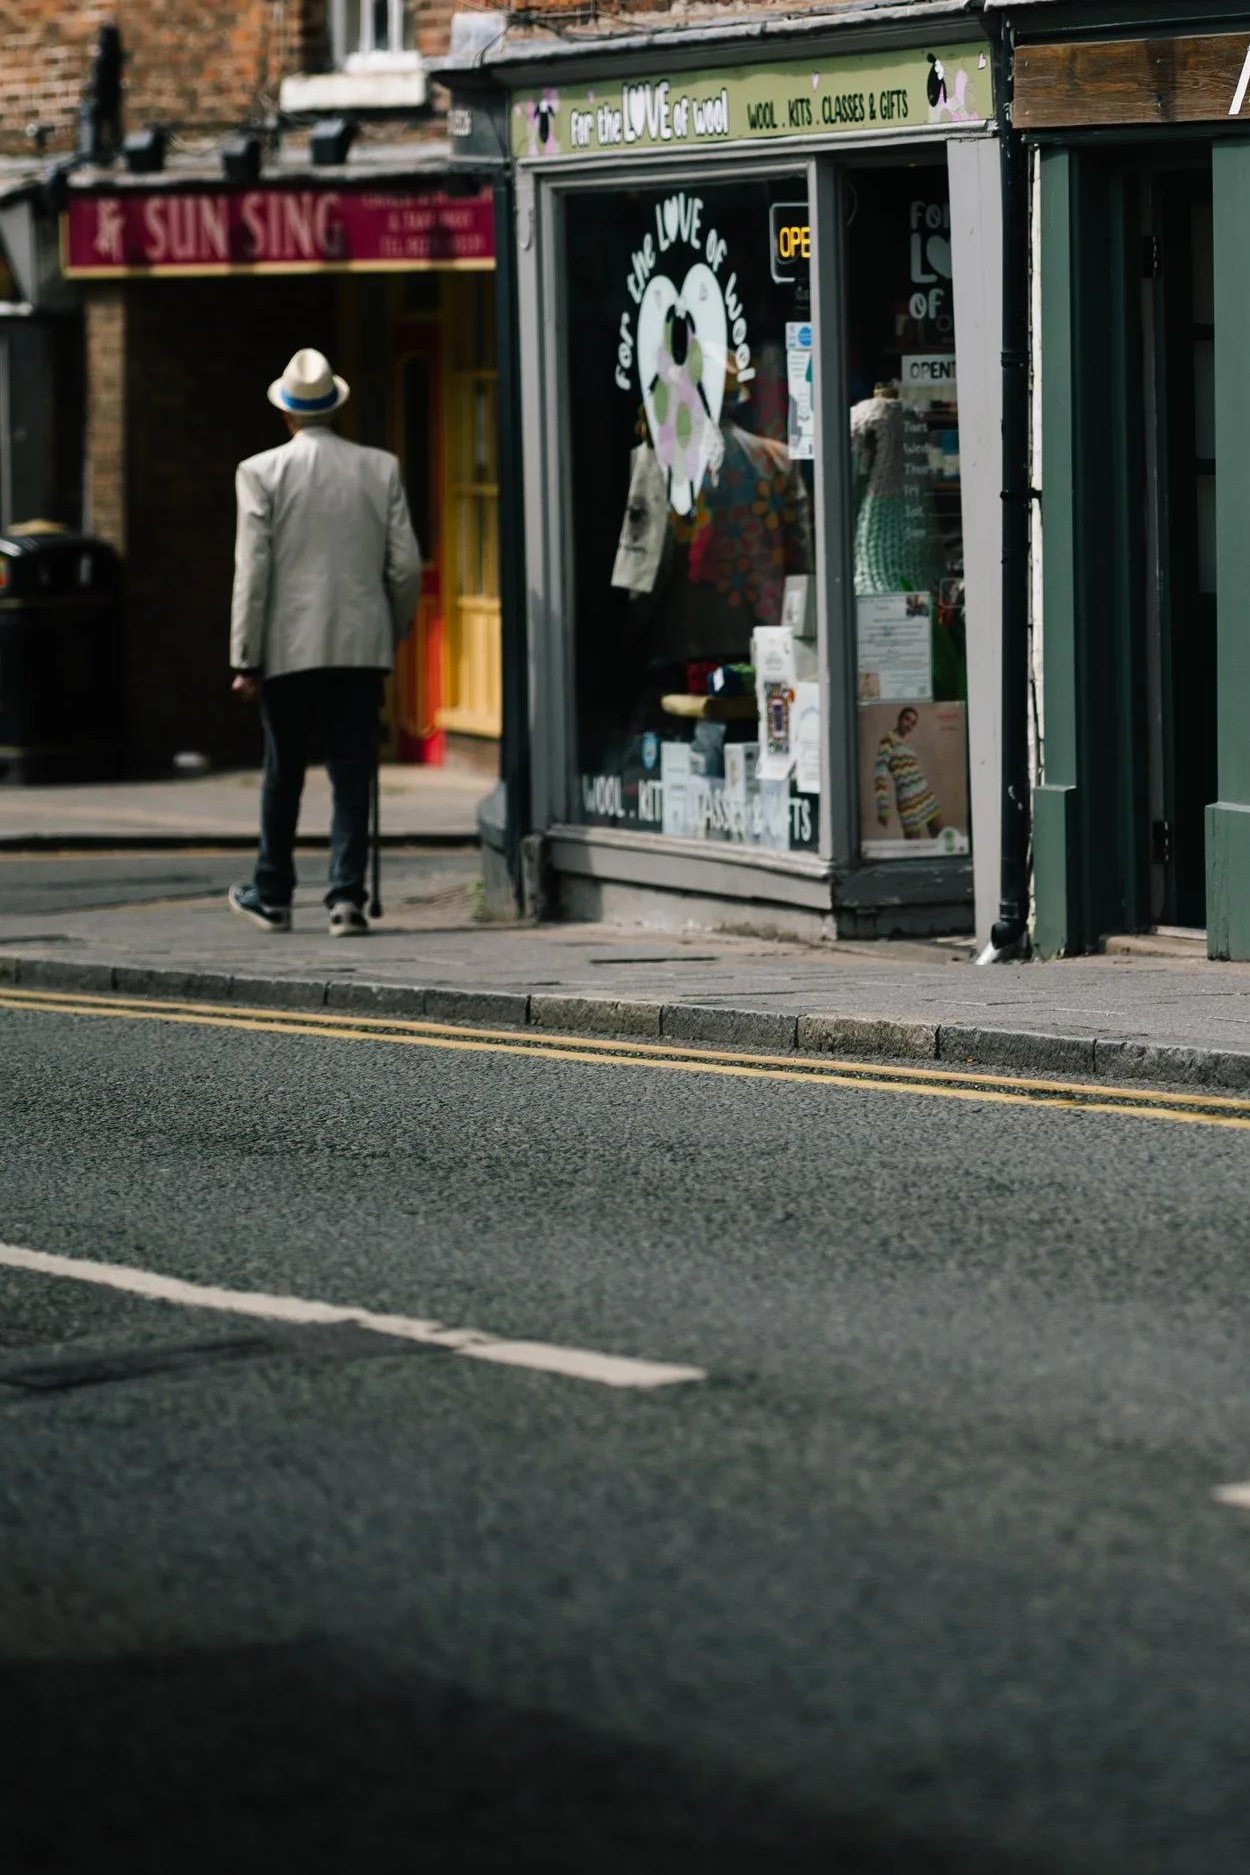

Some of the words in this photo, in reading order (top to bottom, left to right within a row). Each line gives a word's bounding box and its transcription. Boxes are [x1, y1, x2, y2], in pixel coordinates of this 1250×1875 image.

[747, 101, 778, 130] WOOL
[788, 97, 813, 128] KITS
[822, 93, 866, 125] CLASSES
[868, 93, 877, 121] &
[879, 87, 909, 120] GIFTS
[144, 195, 229, 260] SUN
[242, 192, 343, 259] SING
[779, 226, 812, 259] OPE
[582, 774, 626, 819] WOOL
[638, 780, 663, 823] KIT
